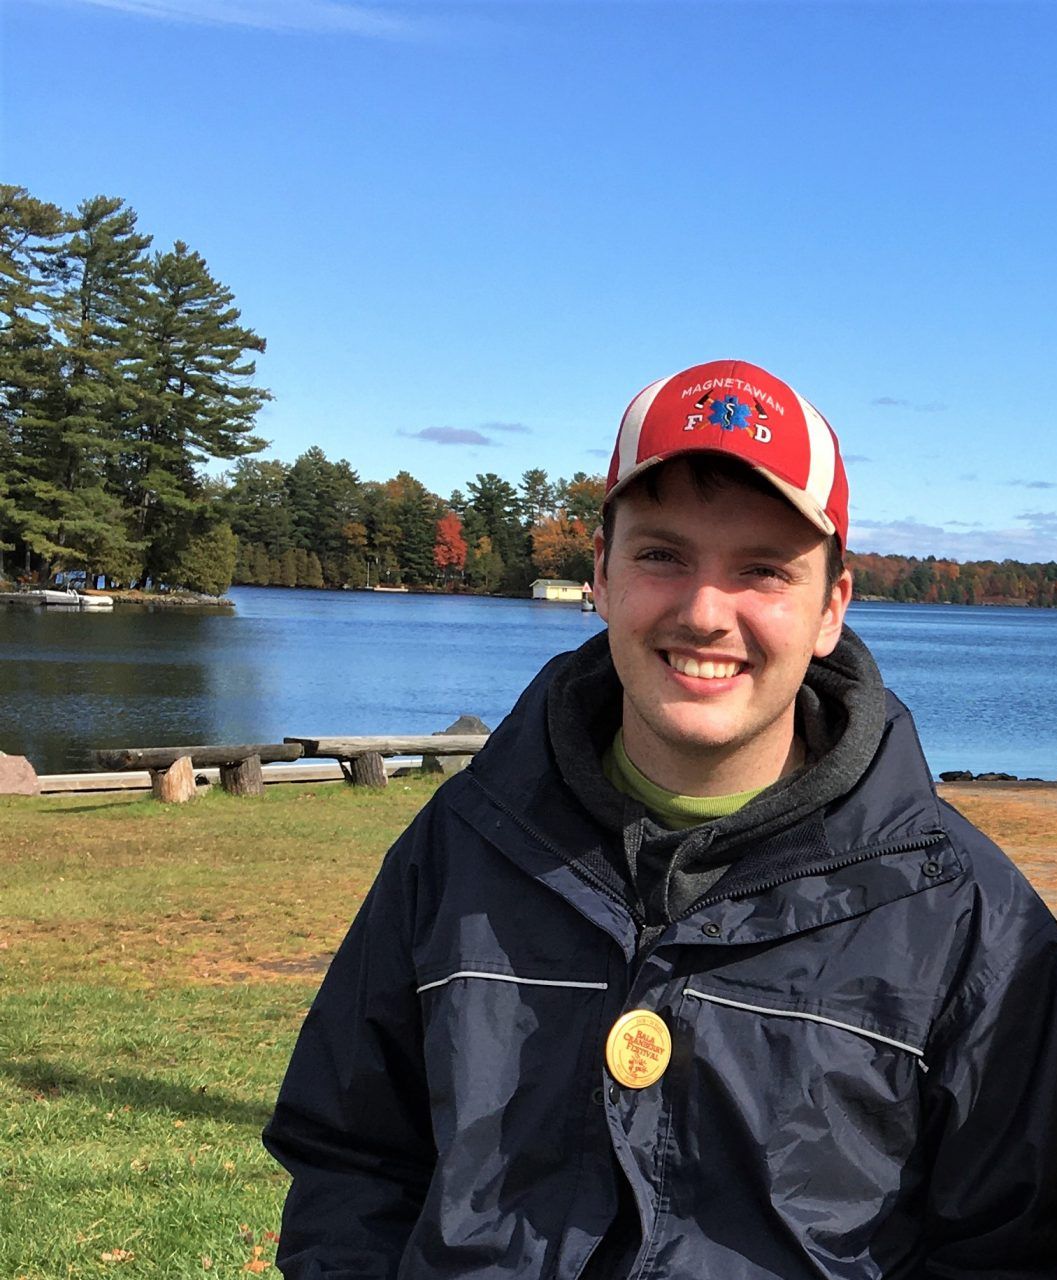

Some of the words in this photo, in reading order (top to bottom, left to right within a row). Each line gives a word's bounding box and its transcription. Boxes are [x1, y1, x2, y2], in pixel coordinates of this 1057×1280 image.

[681, 378, 785, 416] MAGNETAWAN
[684, 414, 703, 431] F
[754, 423, 772, 443] D
[623, 1033, 665, 1056] CRANBERRY
[636, 1030, 655, 1044] BALA
[626, 1043, 659, 1062] FESTIVAL
